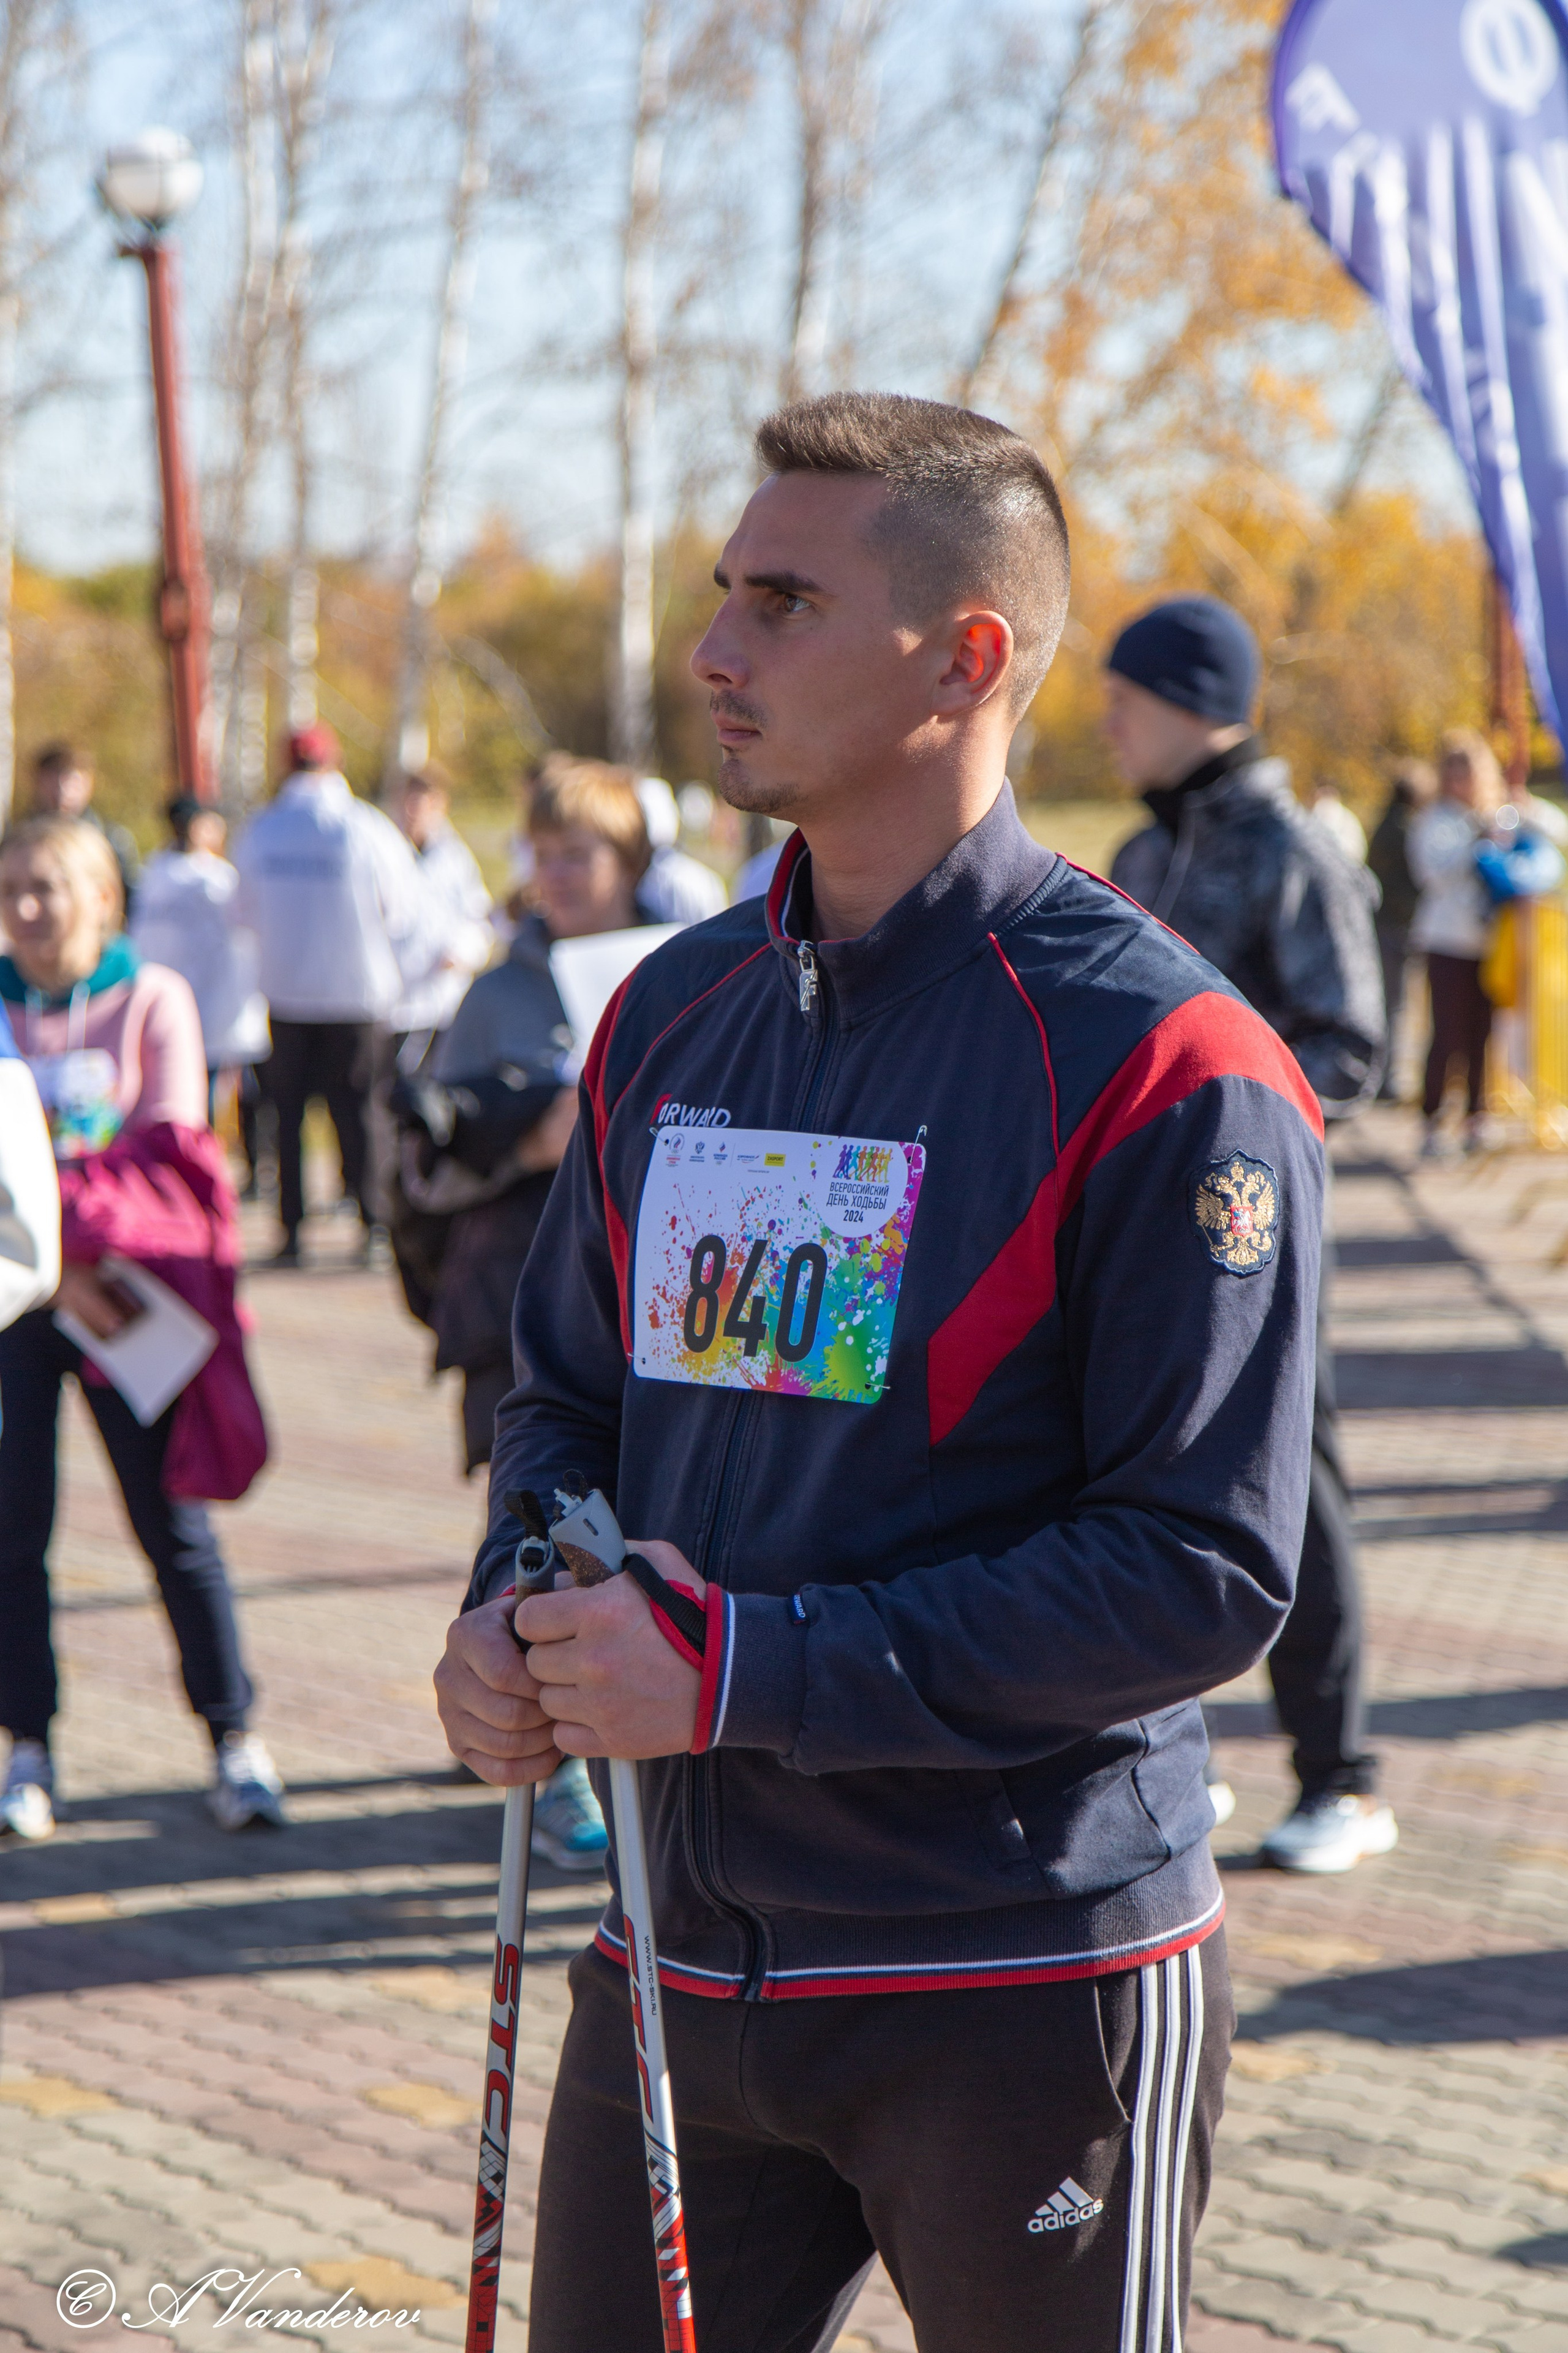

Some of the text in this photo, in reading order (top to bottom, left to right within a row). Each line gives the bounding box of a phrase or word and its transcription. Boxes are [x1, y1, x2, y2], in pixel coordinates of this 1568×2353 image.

[826, 1193, 887, 1210] ДЕНЬ ХОДЬБЫ
[830, 1182, 889, 1196] ВСЕРОССИЙСКИЙ
[843, 1210, 864, 1223] 2024
[684, 1235, 827, 1362] 840
[644, 1935, 657, 2015] WWW.STC-SKI.RU
[485, 1934, 519, 2140] STC
[1027, 2198, 1104, 2233] adidas
